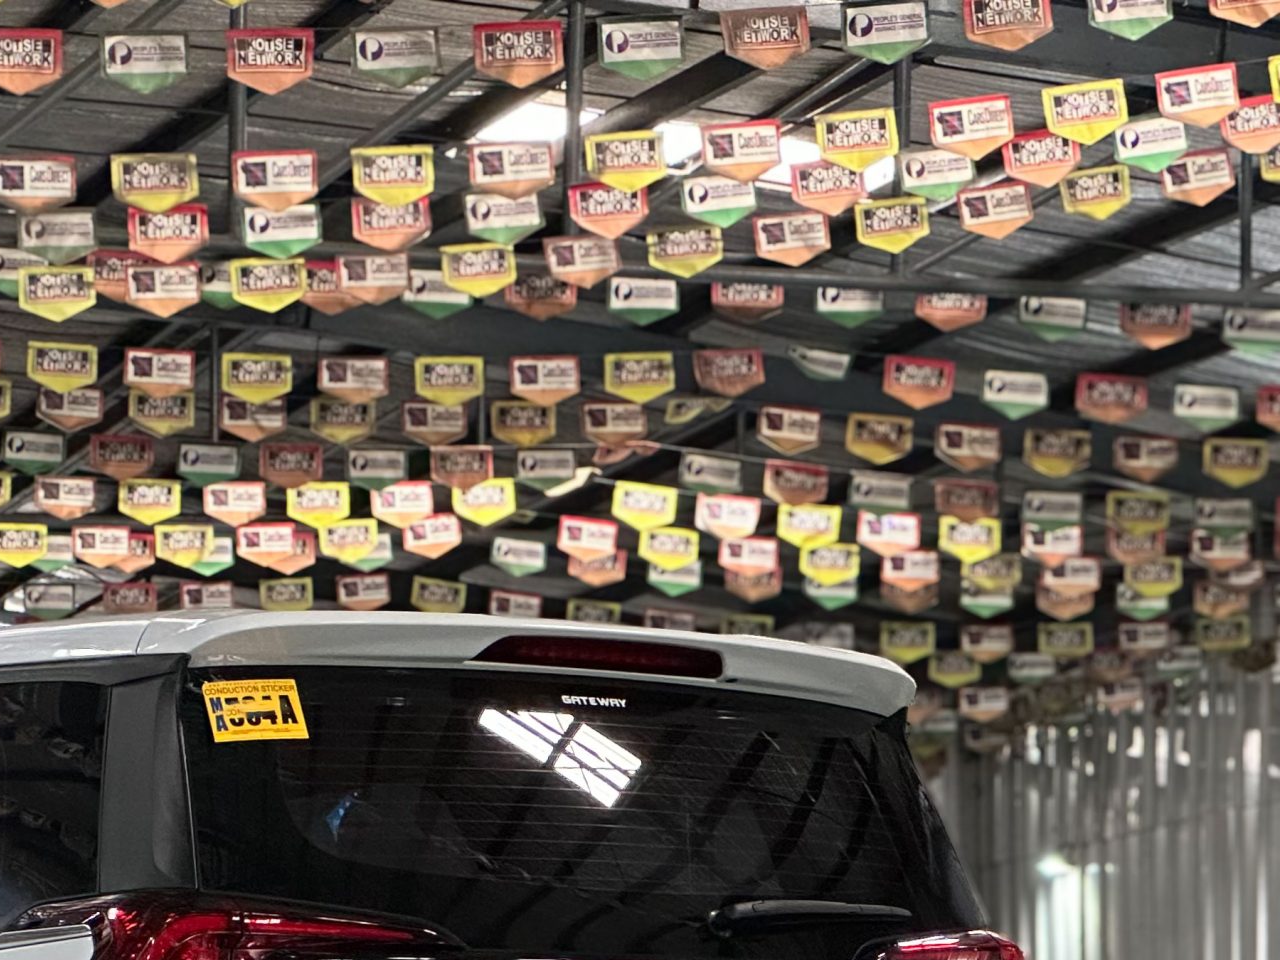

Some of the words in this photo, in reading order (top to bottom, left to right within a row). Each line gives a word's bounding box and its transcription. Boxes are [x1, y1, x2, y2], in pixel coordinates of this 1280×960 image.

[984, 0, 1030, 12] KOTSE
[744, 14, 788, 30] KOTSE
[899, 13, 922, 21] GENERAL
[976, 7, 1042, 27] NETWORK
[495, 31, 541, 48] KOTSE
[734, 27, 799, 44] NETWORK
[249, 37, 295, 53] KOTSE
[486, 45, 552, 60] NETWORK
[239, 51, 304, 67] NETWORK
[1061, 90, 1108, 106] KOTSE
[1056, 101, 1116, 122] NETWORK
[835, 118, 879, 133] KOTSE
[827, 130, 888, 150] NETWORK
[1021, 136, 1063, 152] KOTSE
[1013, 148, 1070, 167] NETWORK
[204, 685, 260, 696] CONDUCTION
[261, 684, 295, 693] STICKER
[561, 695, 626, 708] GATEWAY
